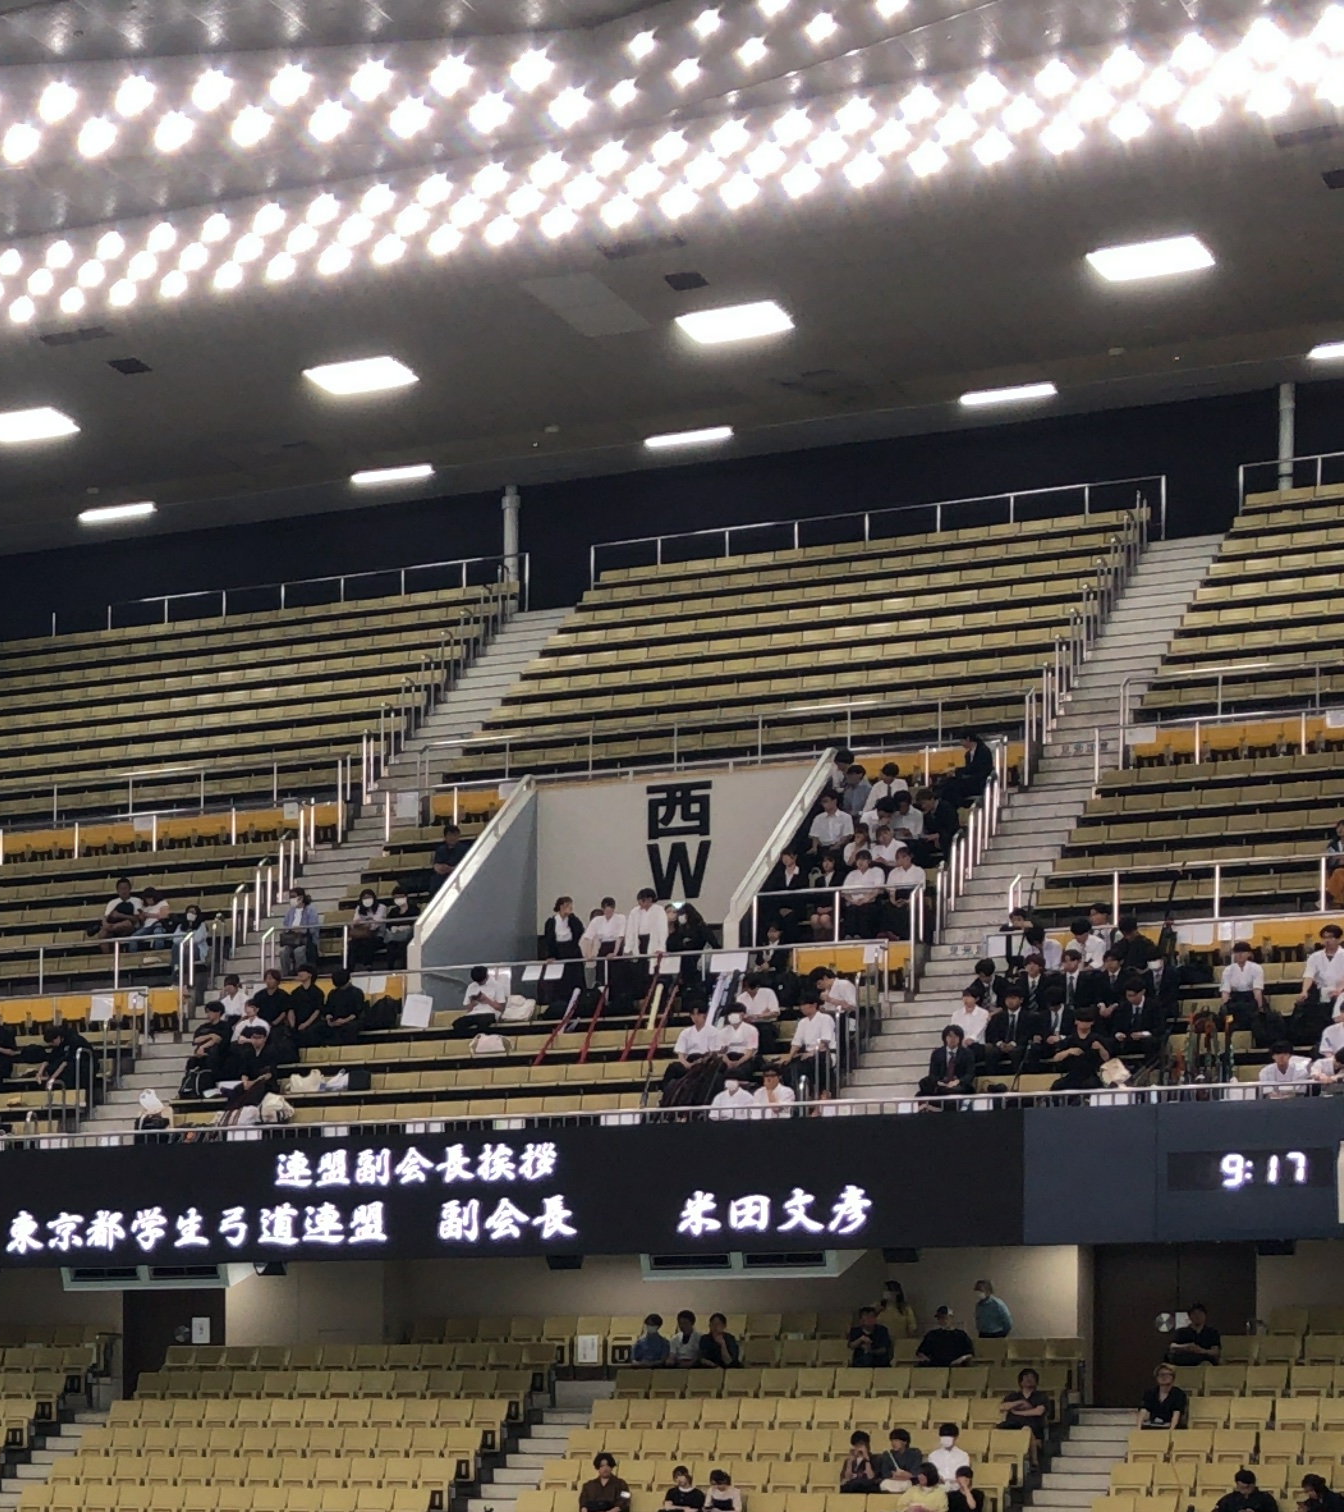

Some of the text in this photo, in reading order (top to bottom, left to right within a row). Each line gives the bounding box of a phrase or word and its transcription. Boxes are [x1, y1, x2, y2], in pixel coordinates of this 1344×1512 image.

[646, 780, 713, 840] 西
[647, 840, 712, 900] W
[274, 1140, 559, 1188] 連盟副会長挨拶
[1220, 1151, 1308, 1188] 9:17
[5, 1200, 389, 1255] 東京都学生弓道連盟
[437, 1193, 579, 1243] 副会長
